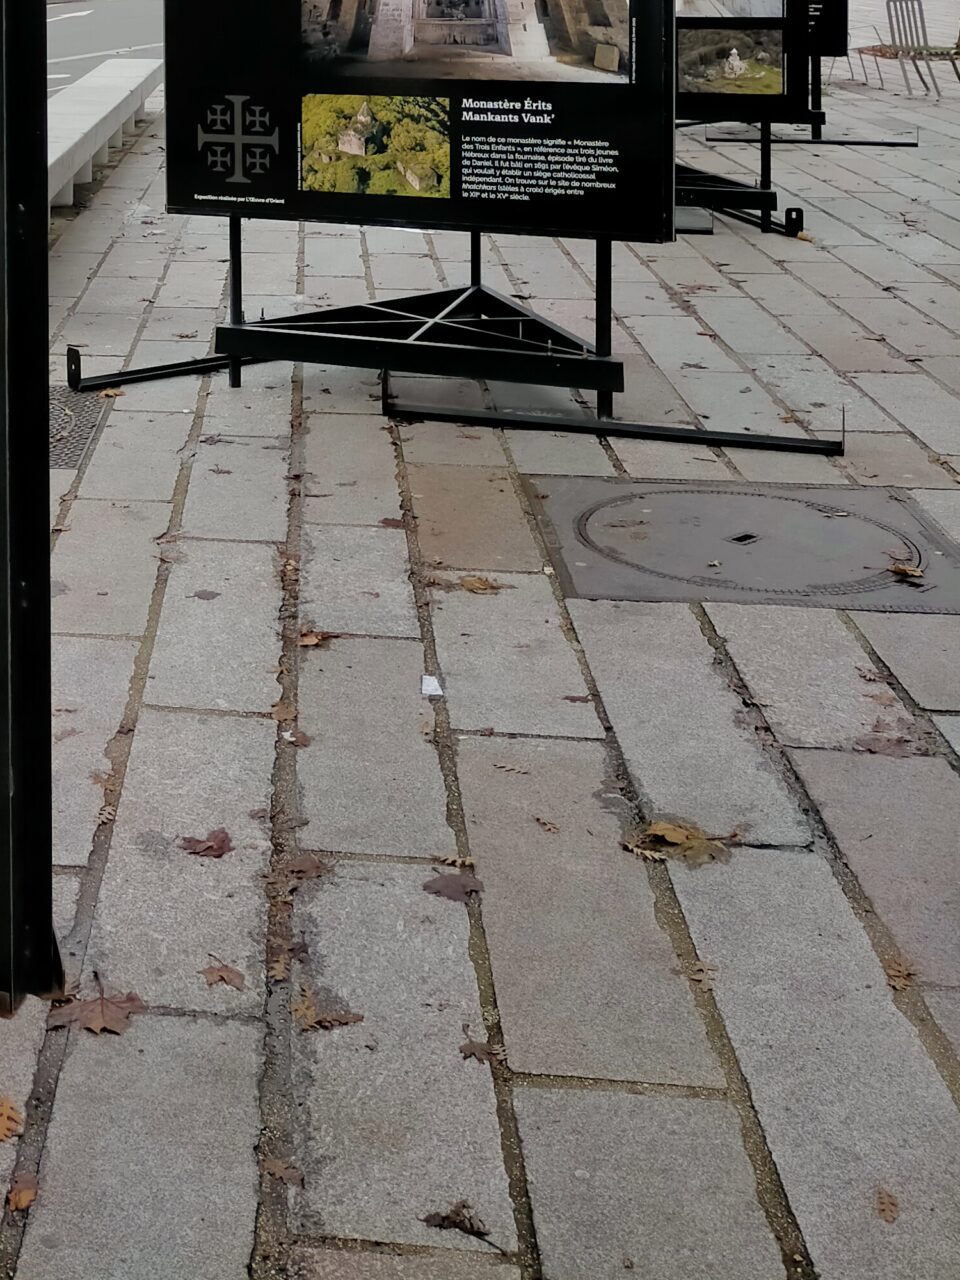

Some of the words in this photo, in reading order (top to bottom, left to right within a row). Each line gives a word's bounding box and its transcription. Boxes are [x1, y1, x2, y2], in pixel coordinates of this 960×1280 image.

[461, 98, 521, 109] Monastère
[524, 98, 552, 110] Érits
[461, 111, 519, 122] Mankants
